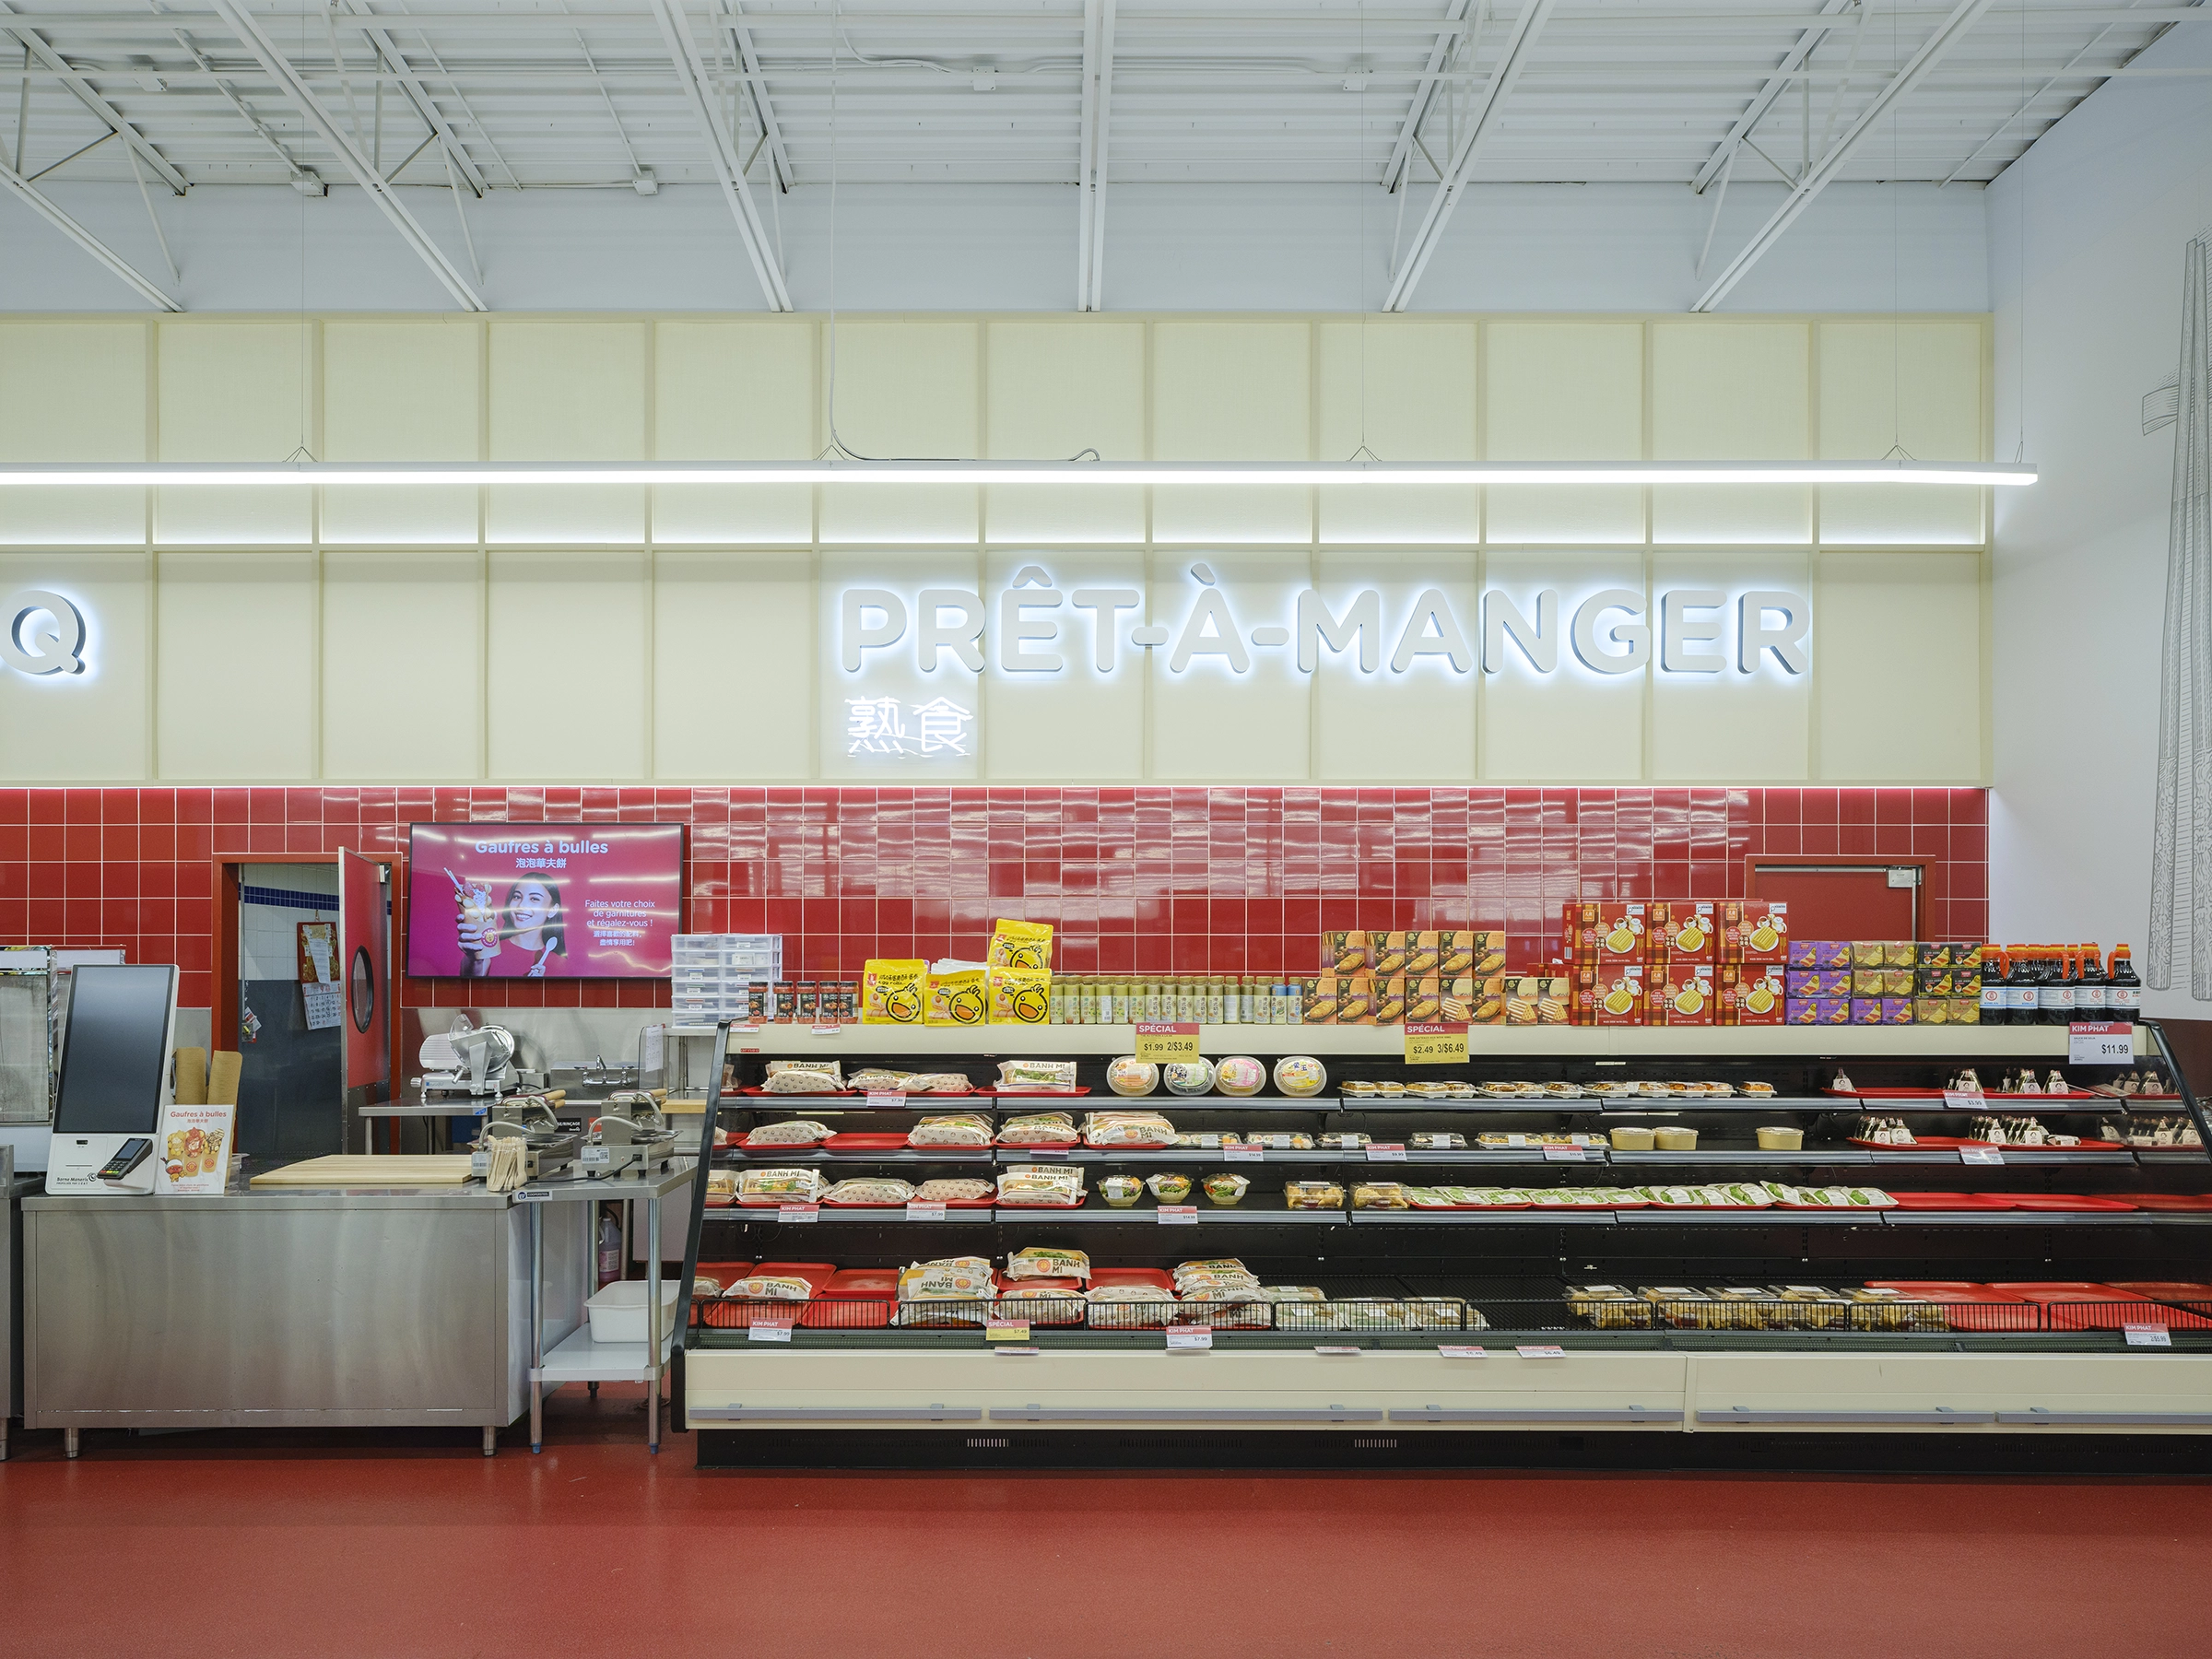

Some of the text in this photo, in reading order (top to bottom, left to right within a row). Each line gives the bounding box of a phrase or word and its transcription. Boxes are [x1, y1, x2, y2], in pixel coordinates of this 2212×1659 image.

[841, 562, 1811, 675] PRÊT-À-MANGER
[844, 696, 973, 756] 熟食
[475, 840, 608, 853] Gaufres à bulles
[515, 858, 567, 869] 泡泡華夫餅
[606, 910, 647, 918] garnitures
[597, 919, 648, 928] régalez-vous
[1139, 1024, 1177, 1033] SPÉCIAL
[1407, 1024, 1445, 1033] SPÉCIAL
[1167, 1042, 1193, 1051] 2/$3.49
[1437, 1043, 1464, 1053] 3/$6.49
[2101, 1044, 2129, 1054] $11.99
[1139, 1126, 1168, 1135] BANH
[1053, 1259, 1080, 1268] BANH
[765, 1282, 797, 1296] BANH MI
[1213, 1292, 1226, 1300] MI
